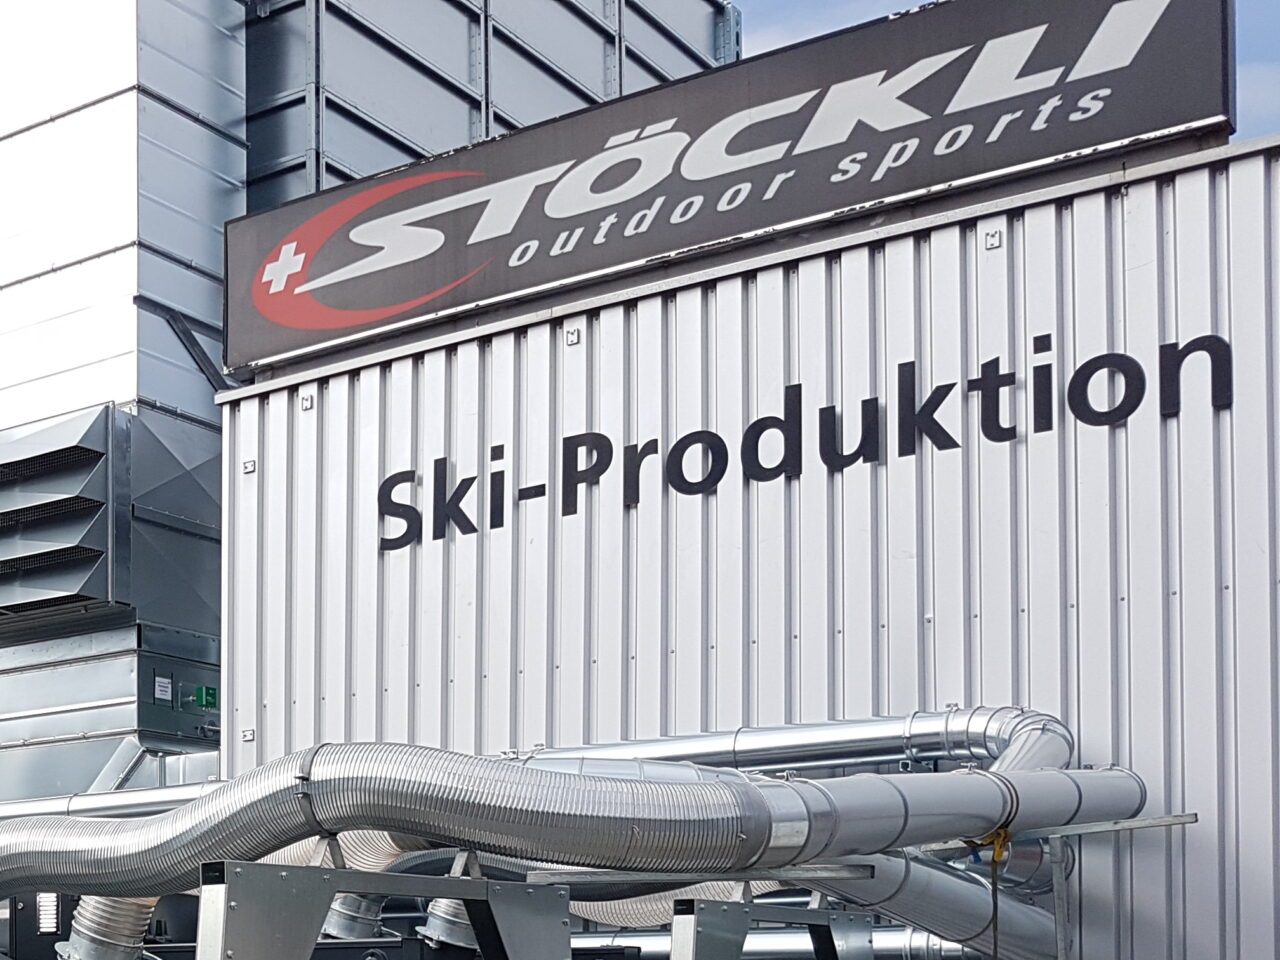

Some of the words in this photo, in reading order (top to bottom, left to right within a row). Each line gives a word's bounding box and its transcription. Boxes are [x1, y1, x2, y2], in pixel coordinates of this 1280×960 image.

[294, 0, 1172, 295] STÖCKLI
[507, 168, 796, 268] outdoor
[830, 87, 1112, 183] sports
[377, 333, 1233, 551] Ski-Produktion
